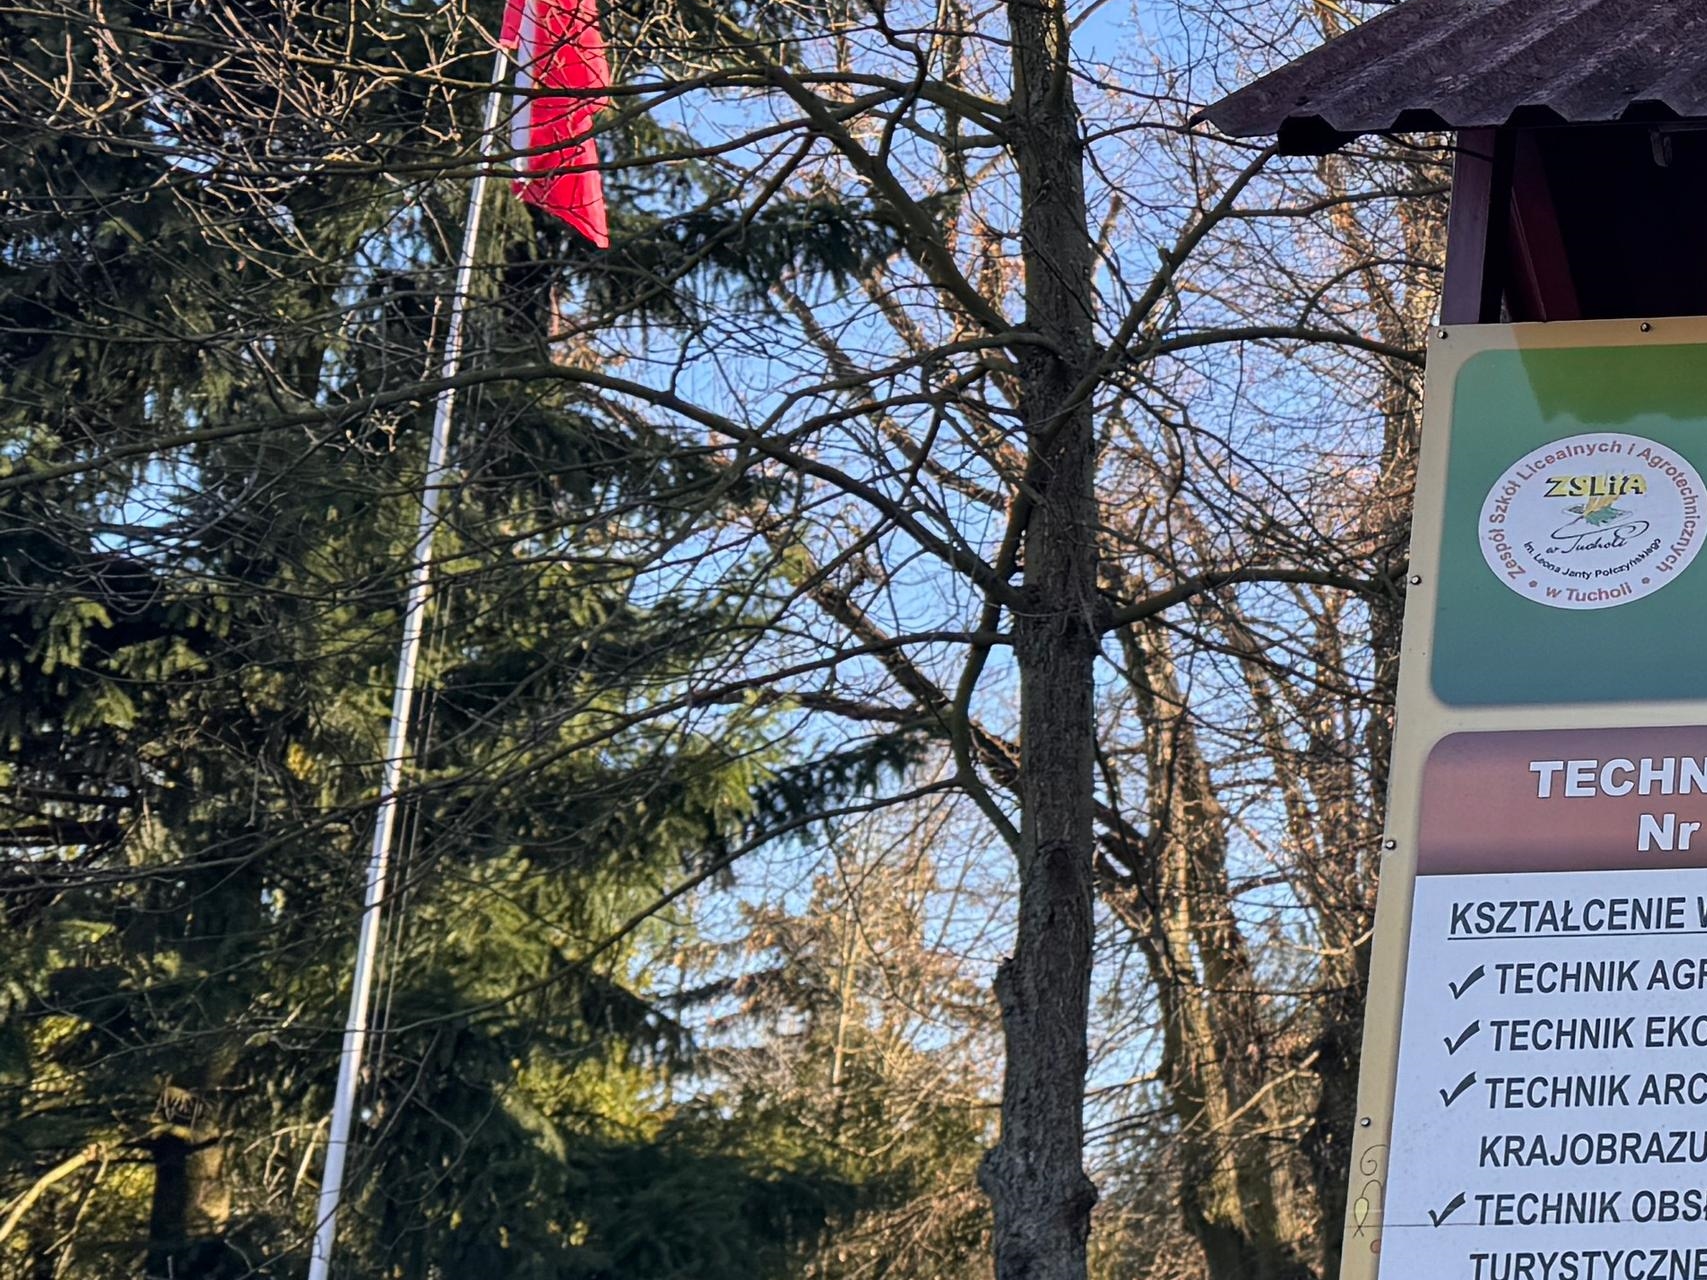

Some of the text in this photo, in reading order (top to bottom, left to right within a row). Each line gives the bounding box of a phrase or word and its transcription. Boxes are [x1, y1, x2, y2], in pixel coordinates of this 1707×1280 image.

[1516, 440, 1622, 481] Licealnych
[1566, 582, 1633, 602] Tucholi
[1638, 814, 1700, 850] Nr
[1448, 897, 1689, 937] KSZTAŁCENIE
[1495, 960, 1640, 994] TECHNIK
[1490, 1017, 1635, 1051] TECHNIK
[1485, 1075, 1630, 1108] TECHNIK
[1475, 1191, 1621, 1226] TECHNIK
